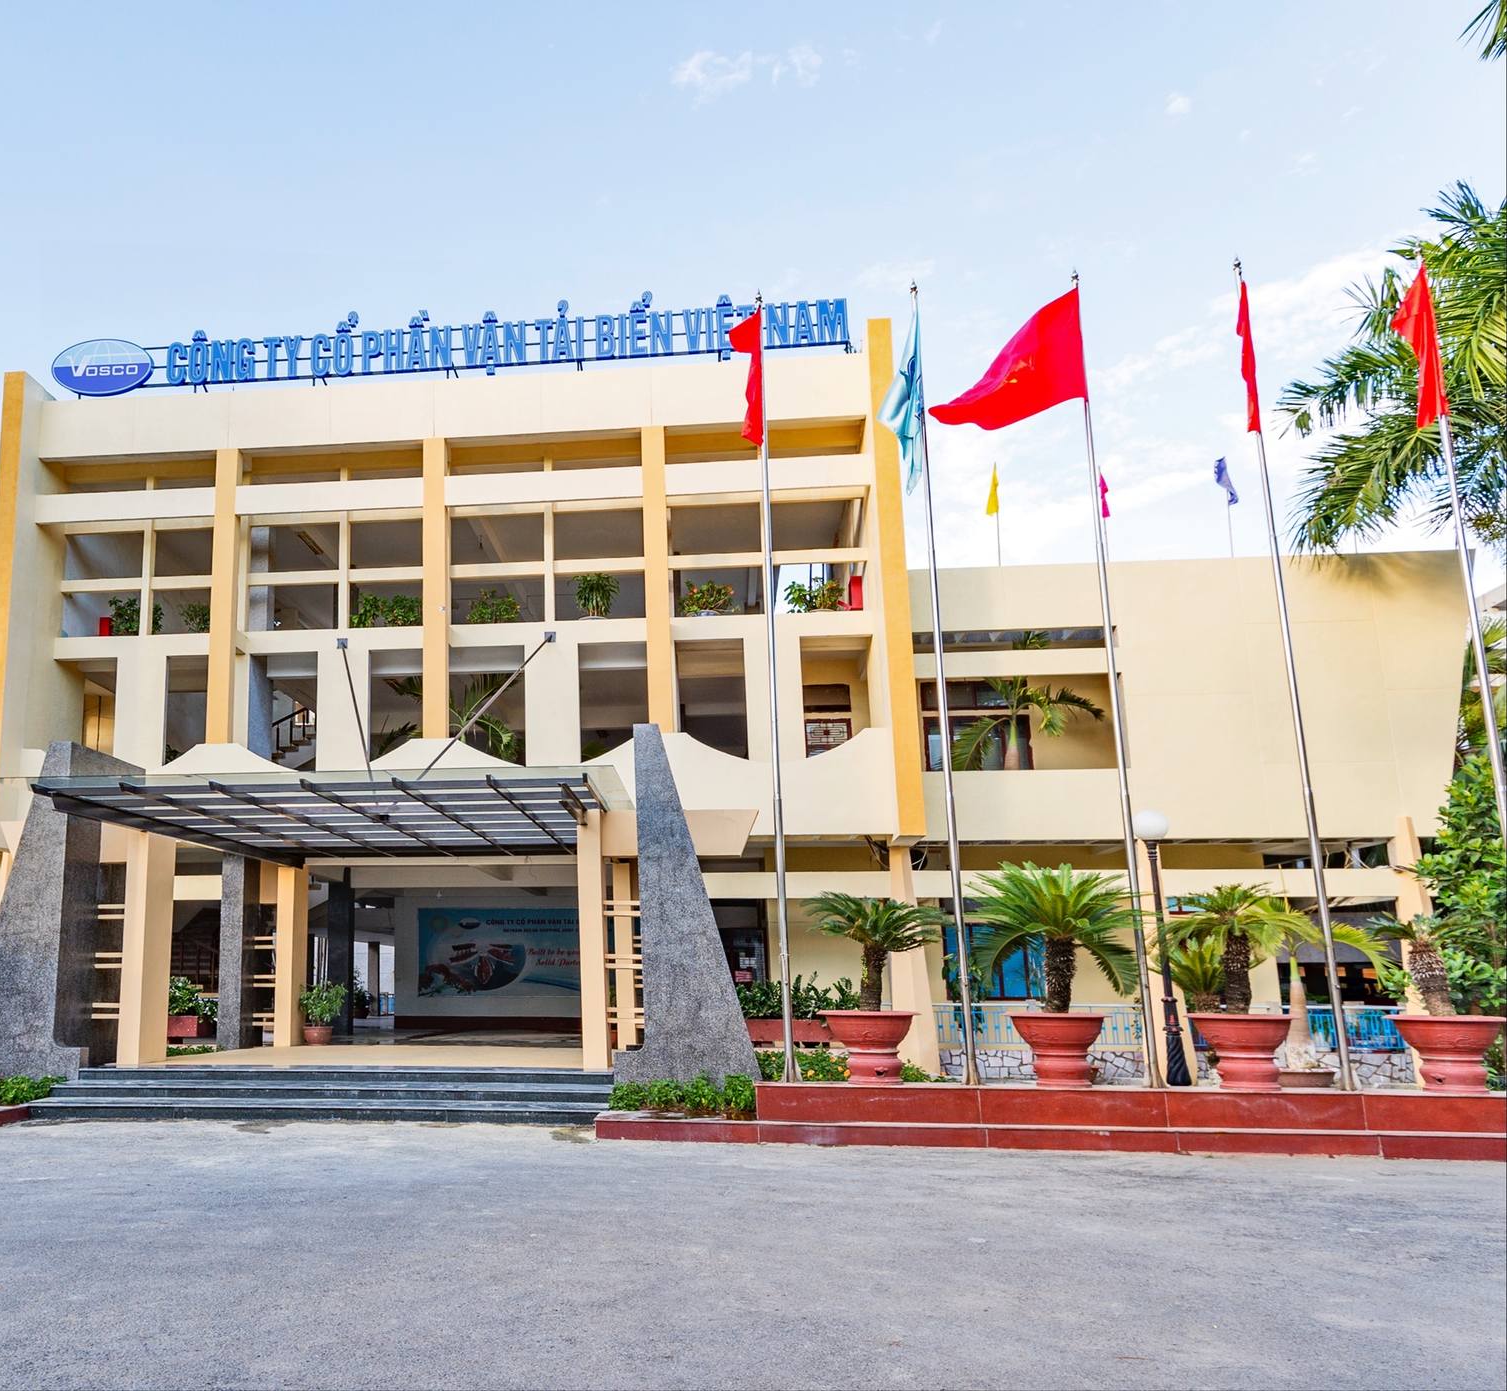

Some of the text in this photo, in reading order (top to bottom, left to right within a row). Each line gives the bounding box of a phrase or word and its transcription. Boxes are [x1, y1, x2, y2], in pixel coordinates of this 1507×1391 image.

[166, 329, 256, 386] CÔNG
[264, 335, 303, 379] TY
[310, 310, 360, 378] CỔ
[362, 308, 452, 373] PHẦN
[461, 310, 527, 376] VẬN
[535, 299, 585, 363] TẢI
[594, 290, 673, 359] BIỂN
[765, 298, 850, 348] NAM
